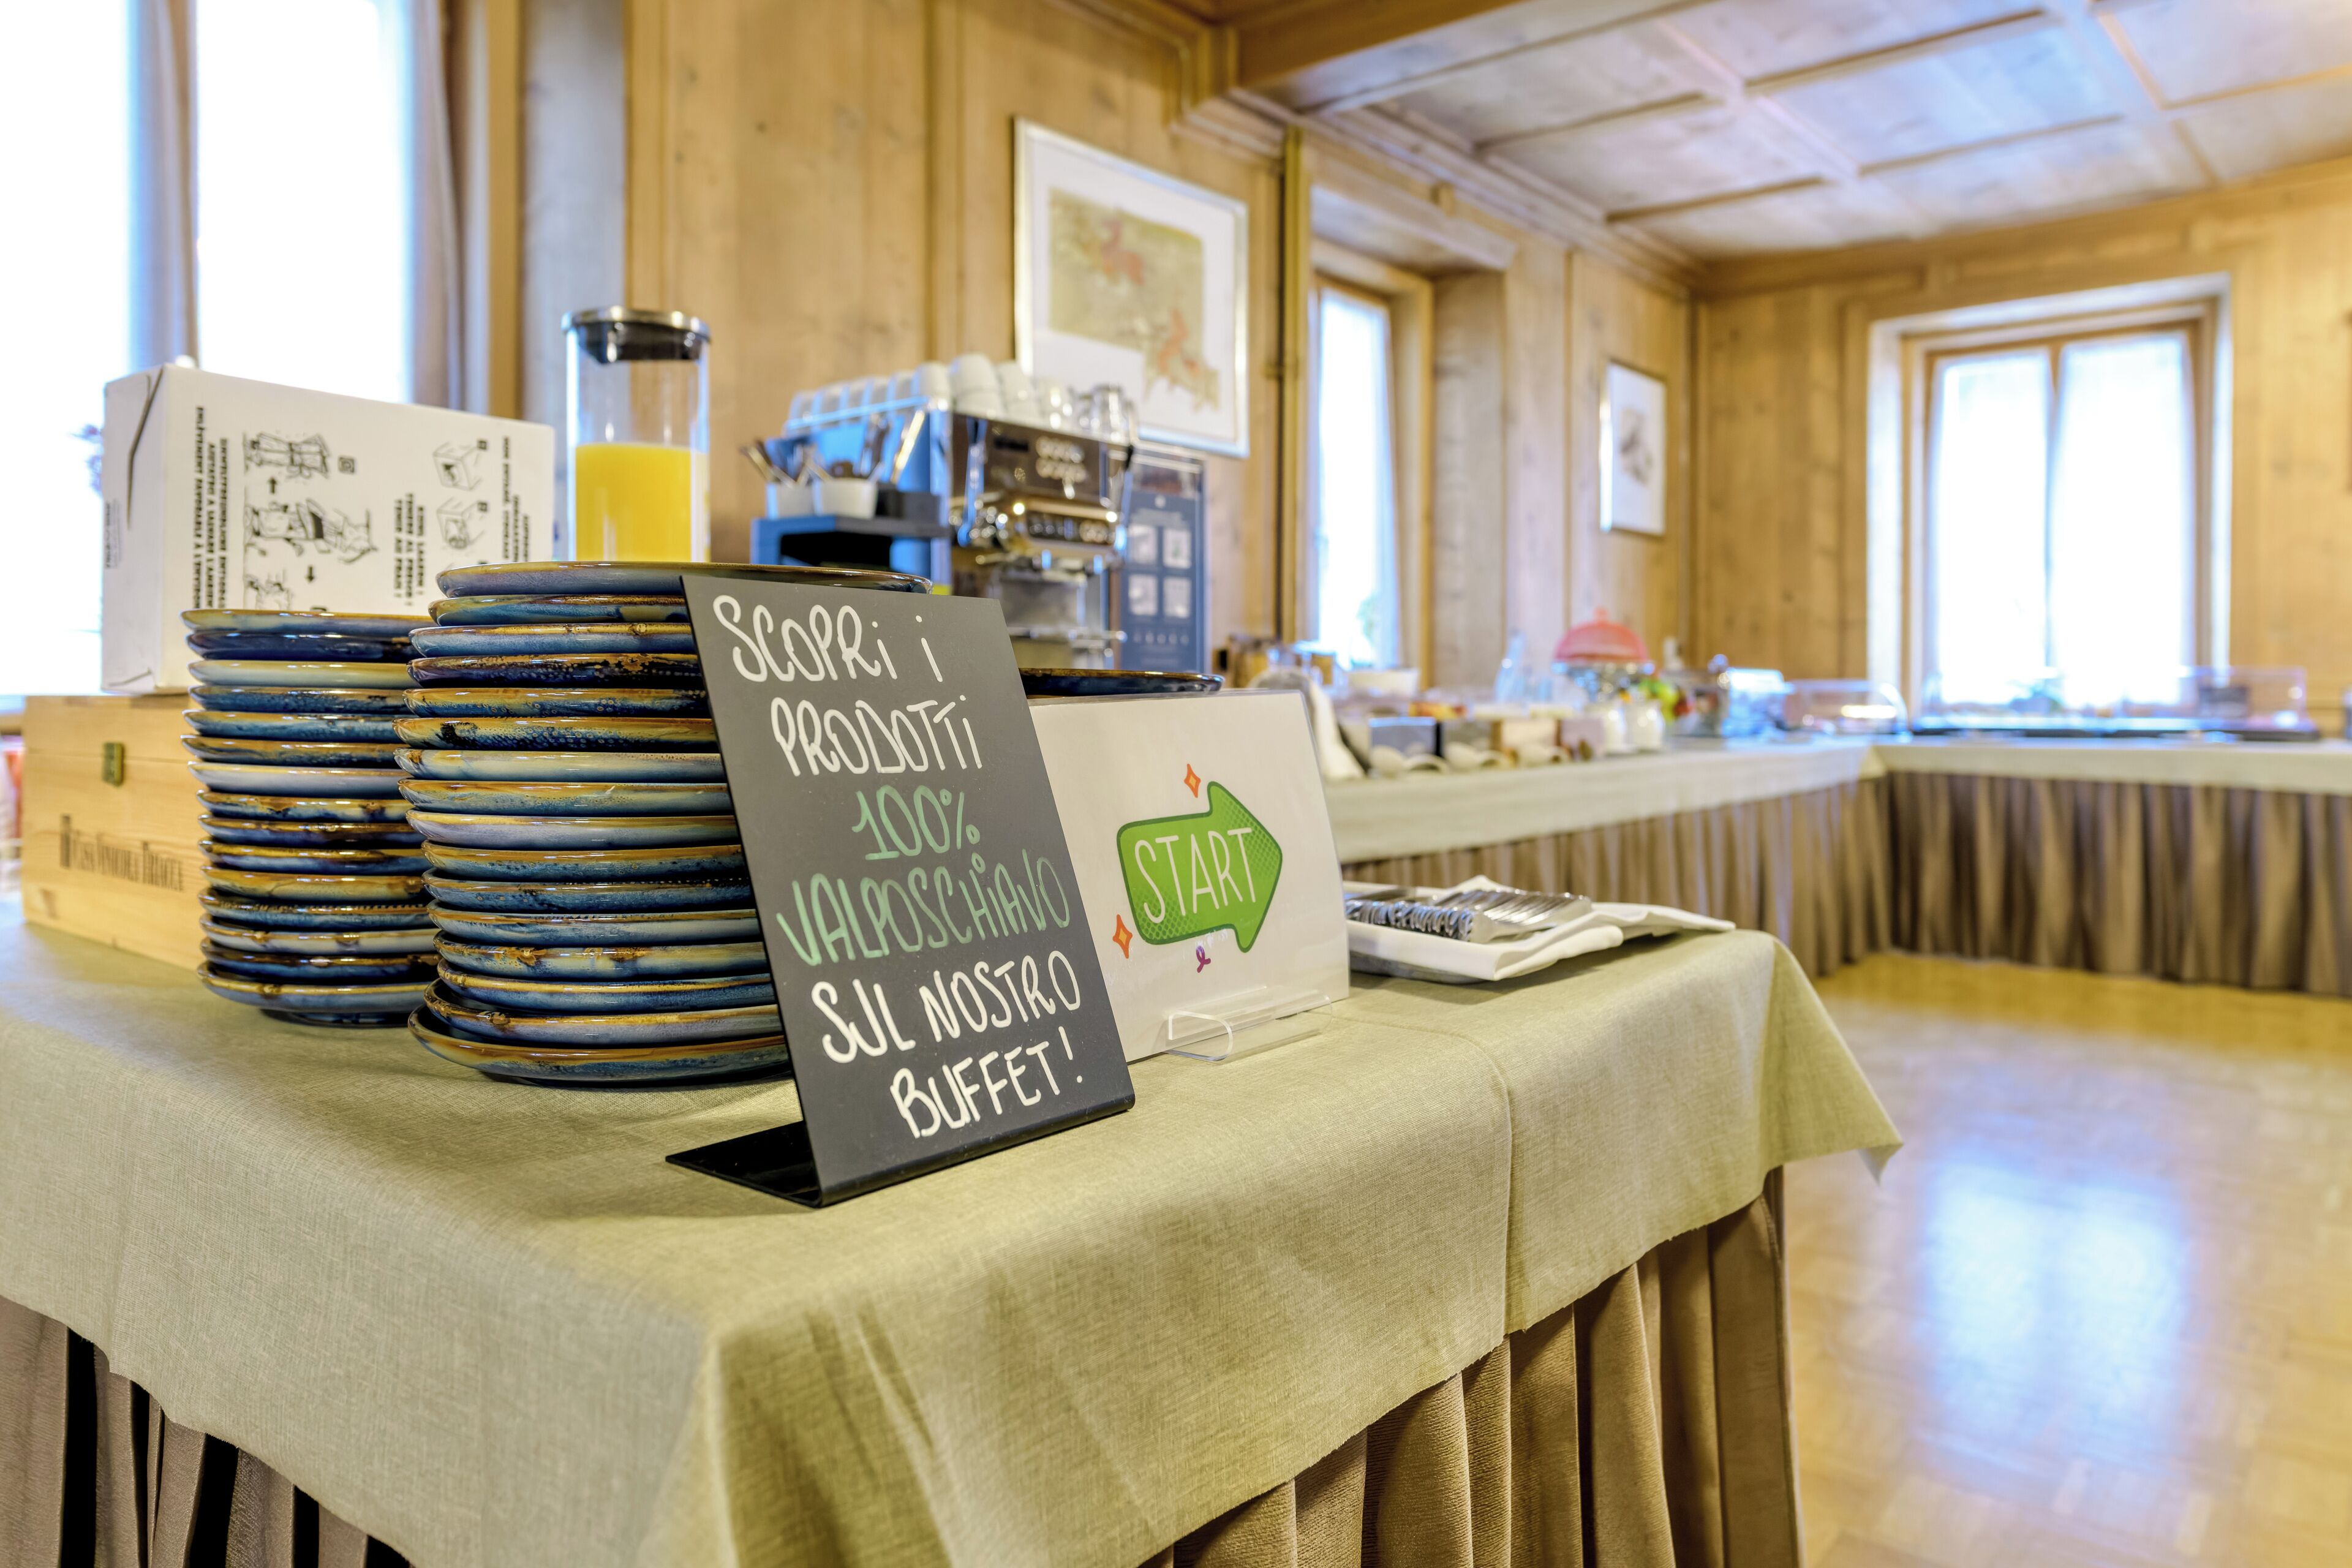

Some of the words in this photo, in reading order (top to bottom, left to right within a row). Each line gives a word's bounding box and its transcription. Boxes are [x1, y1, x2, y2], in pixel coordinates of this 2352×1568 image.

[851, 785, 980, 861] 100%
[1134, 827, 1256, 924] START
[812, 979, 915, 1063] SUL
[919, 949, 1081, 1042] NOSTRO
